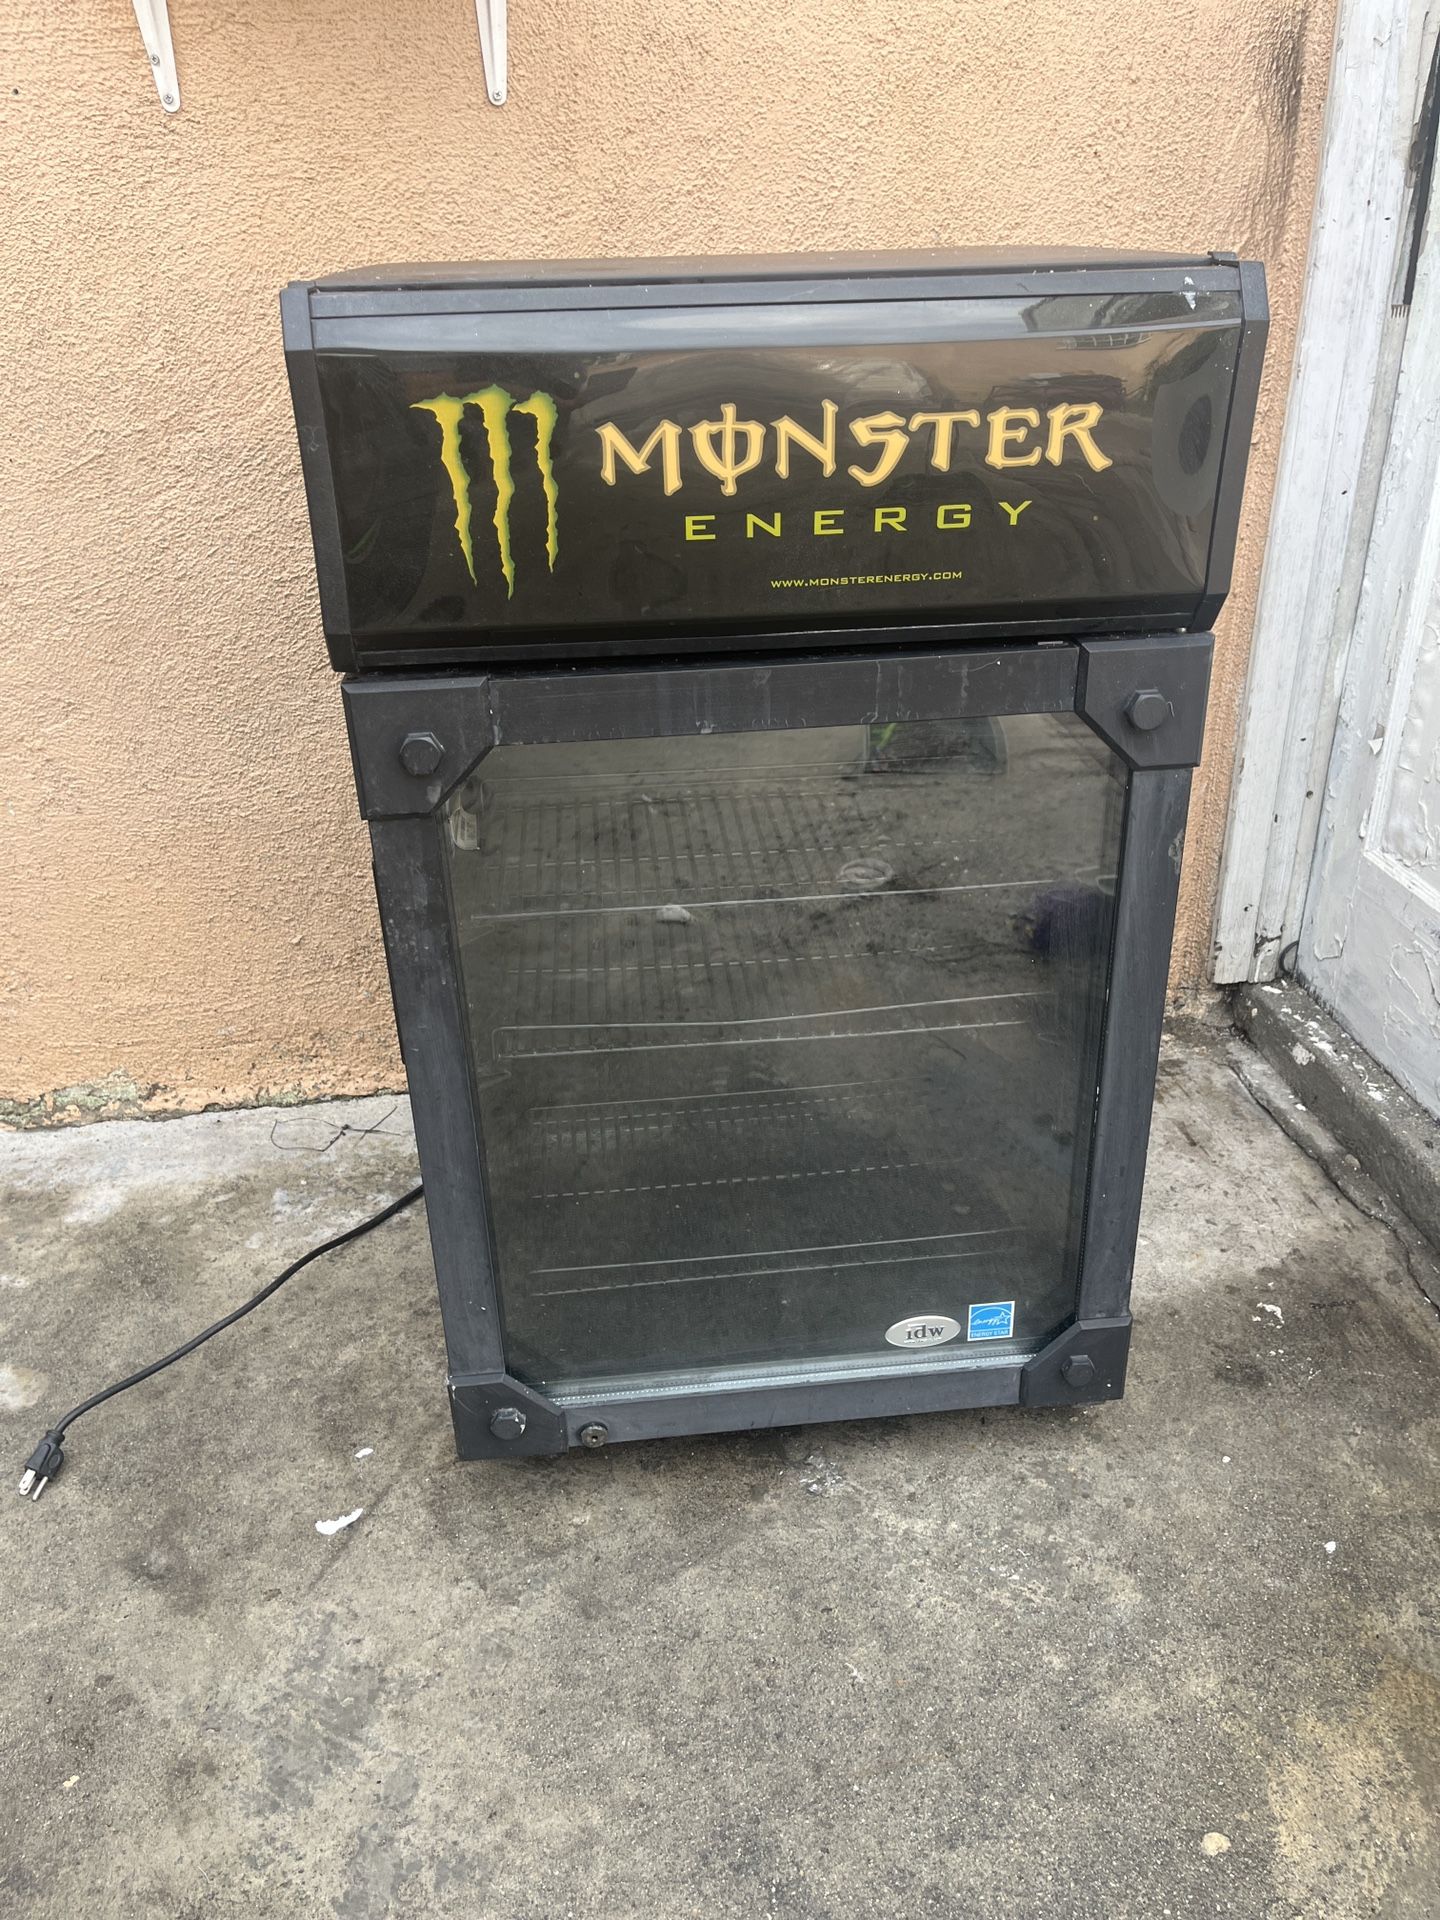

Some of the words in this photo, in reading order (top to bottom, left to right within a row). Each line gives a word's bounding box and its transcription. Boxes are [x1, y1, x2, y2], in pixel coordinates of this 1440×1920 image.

[596, 399, 1112, 496] MONSTER
[685, 500, 1033, 540] ENERGY
[770, 571, 963, 589] WWW.MONSTERENERGY.COM
[906, 1325, 945, 1340] idw
